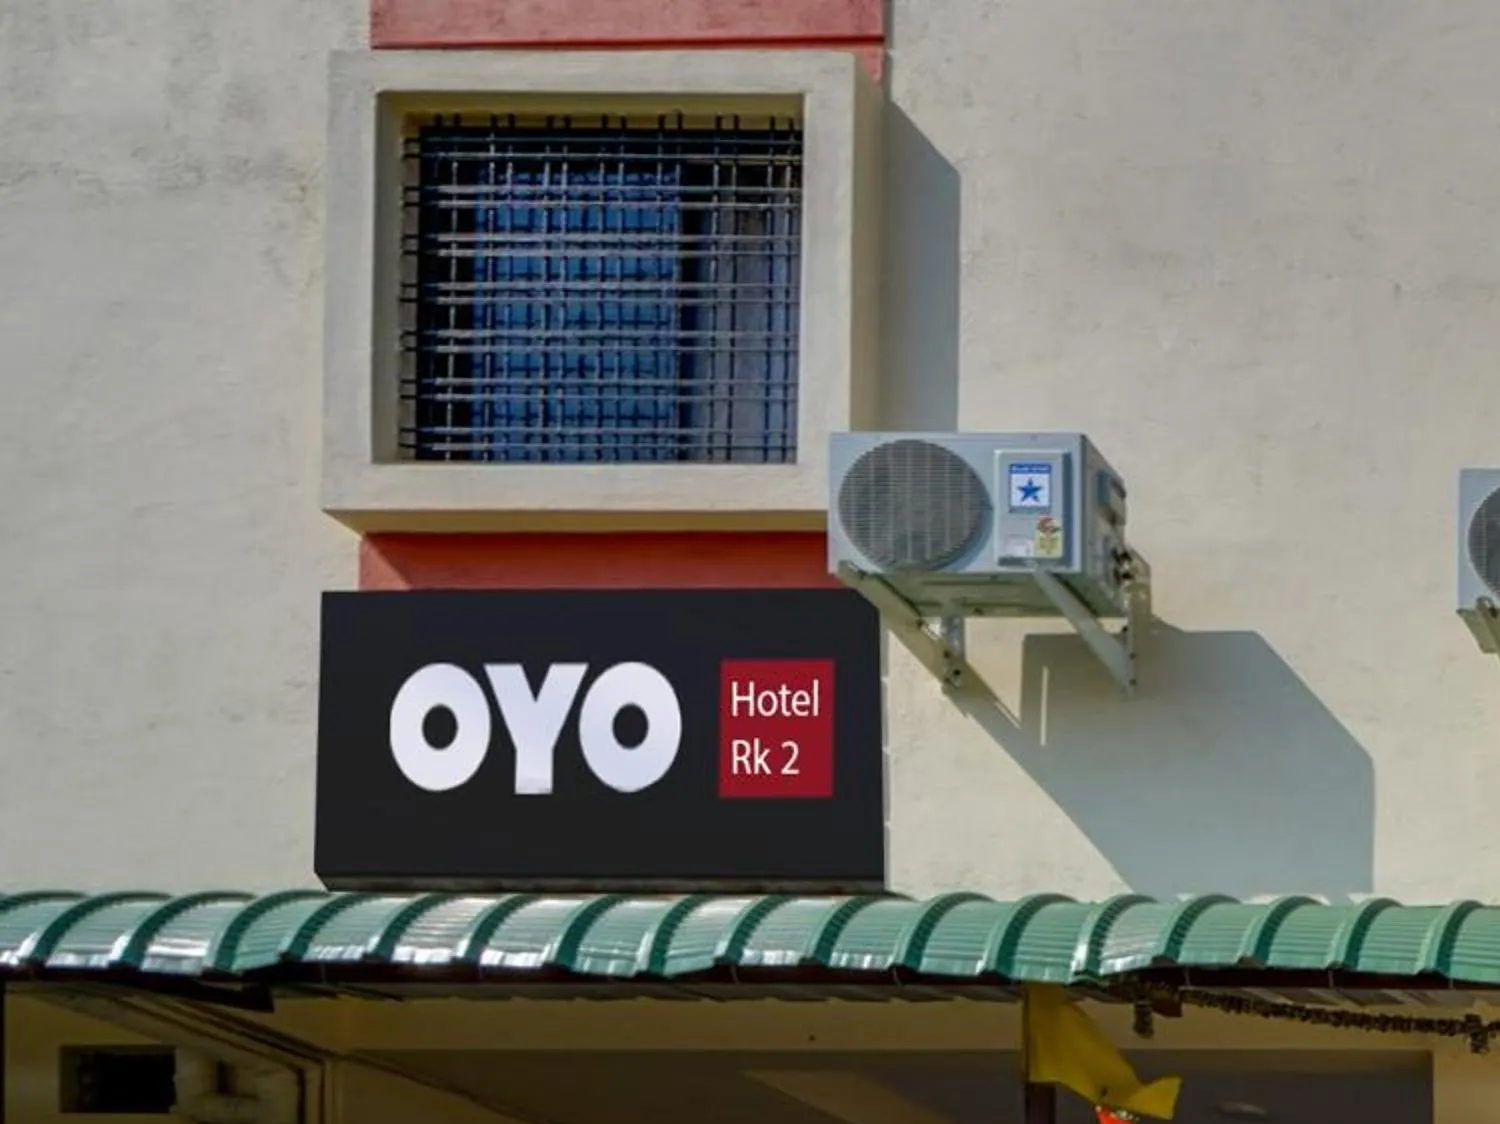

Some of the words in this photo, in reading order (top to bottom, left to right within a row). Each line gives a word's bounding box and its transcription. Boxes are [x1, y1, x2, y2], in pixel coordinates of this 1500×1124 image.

[731, 679, 820, 718] Hotel
[389, 661, 682, 795] OYO
[731, 737, 772, 775] Rk
[780, 740, 800, 775] 2
